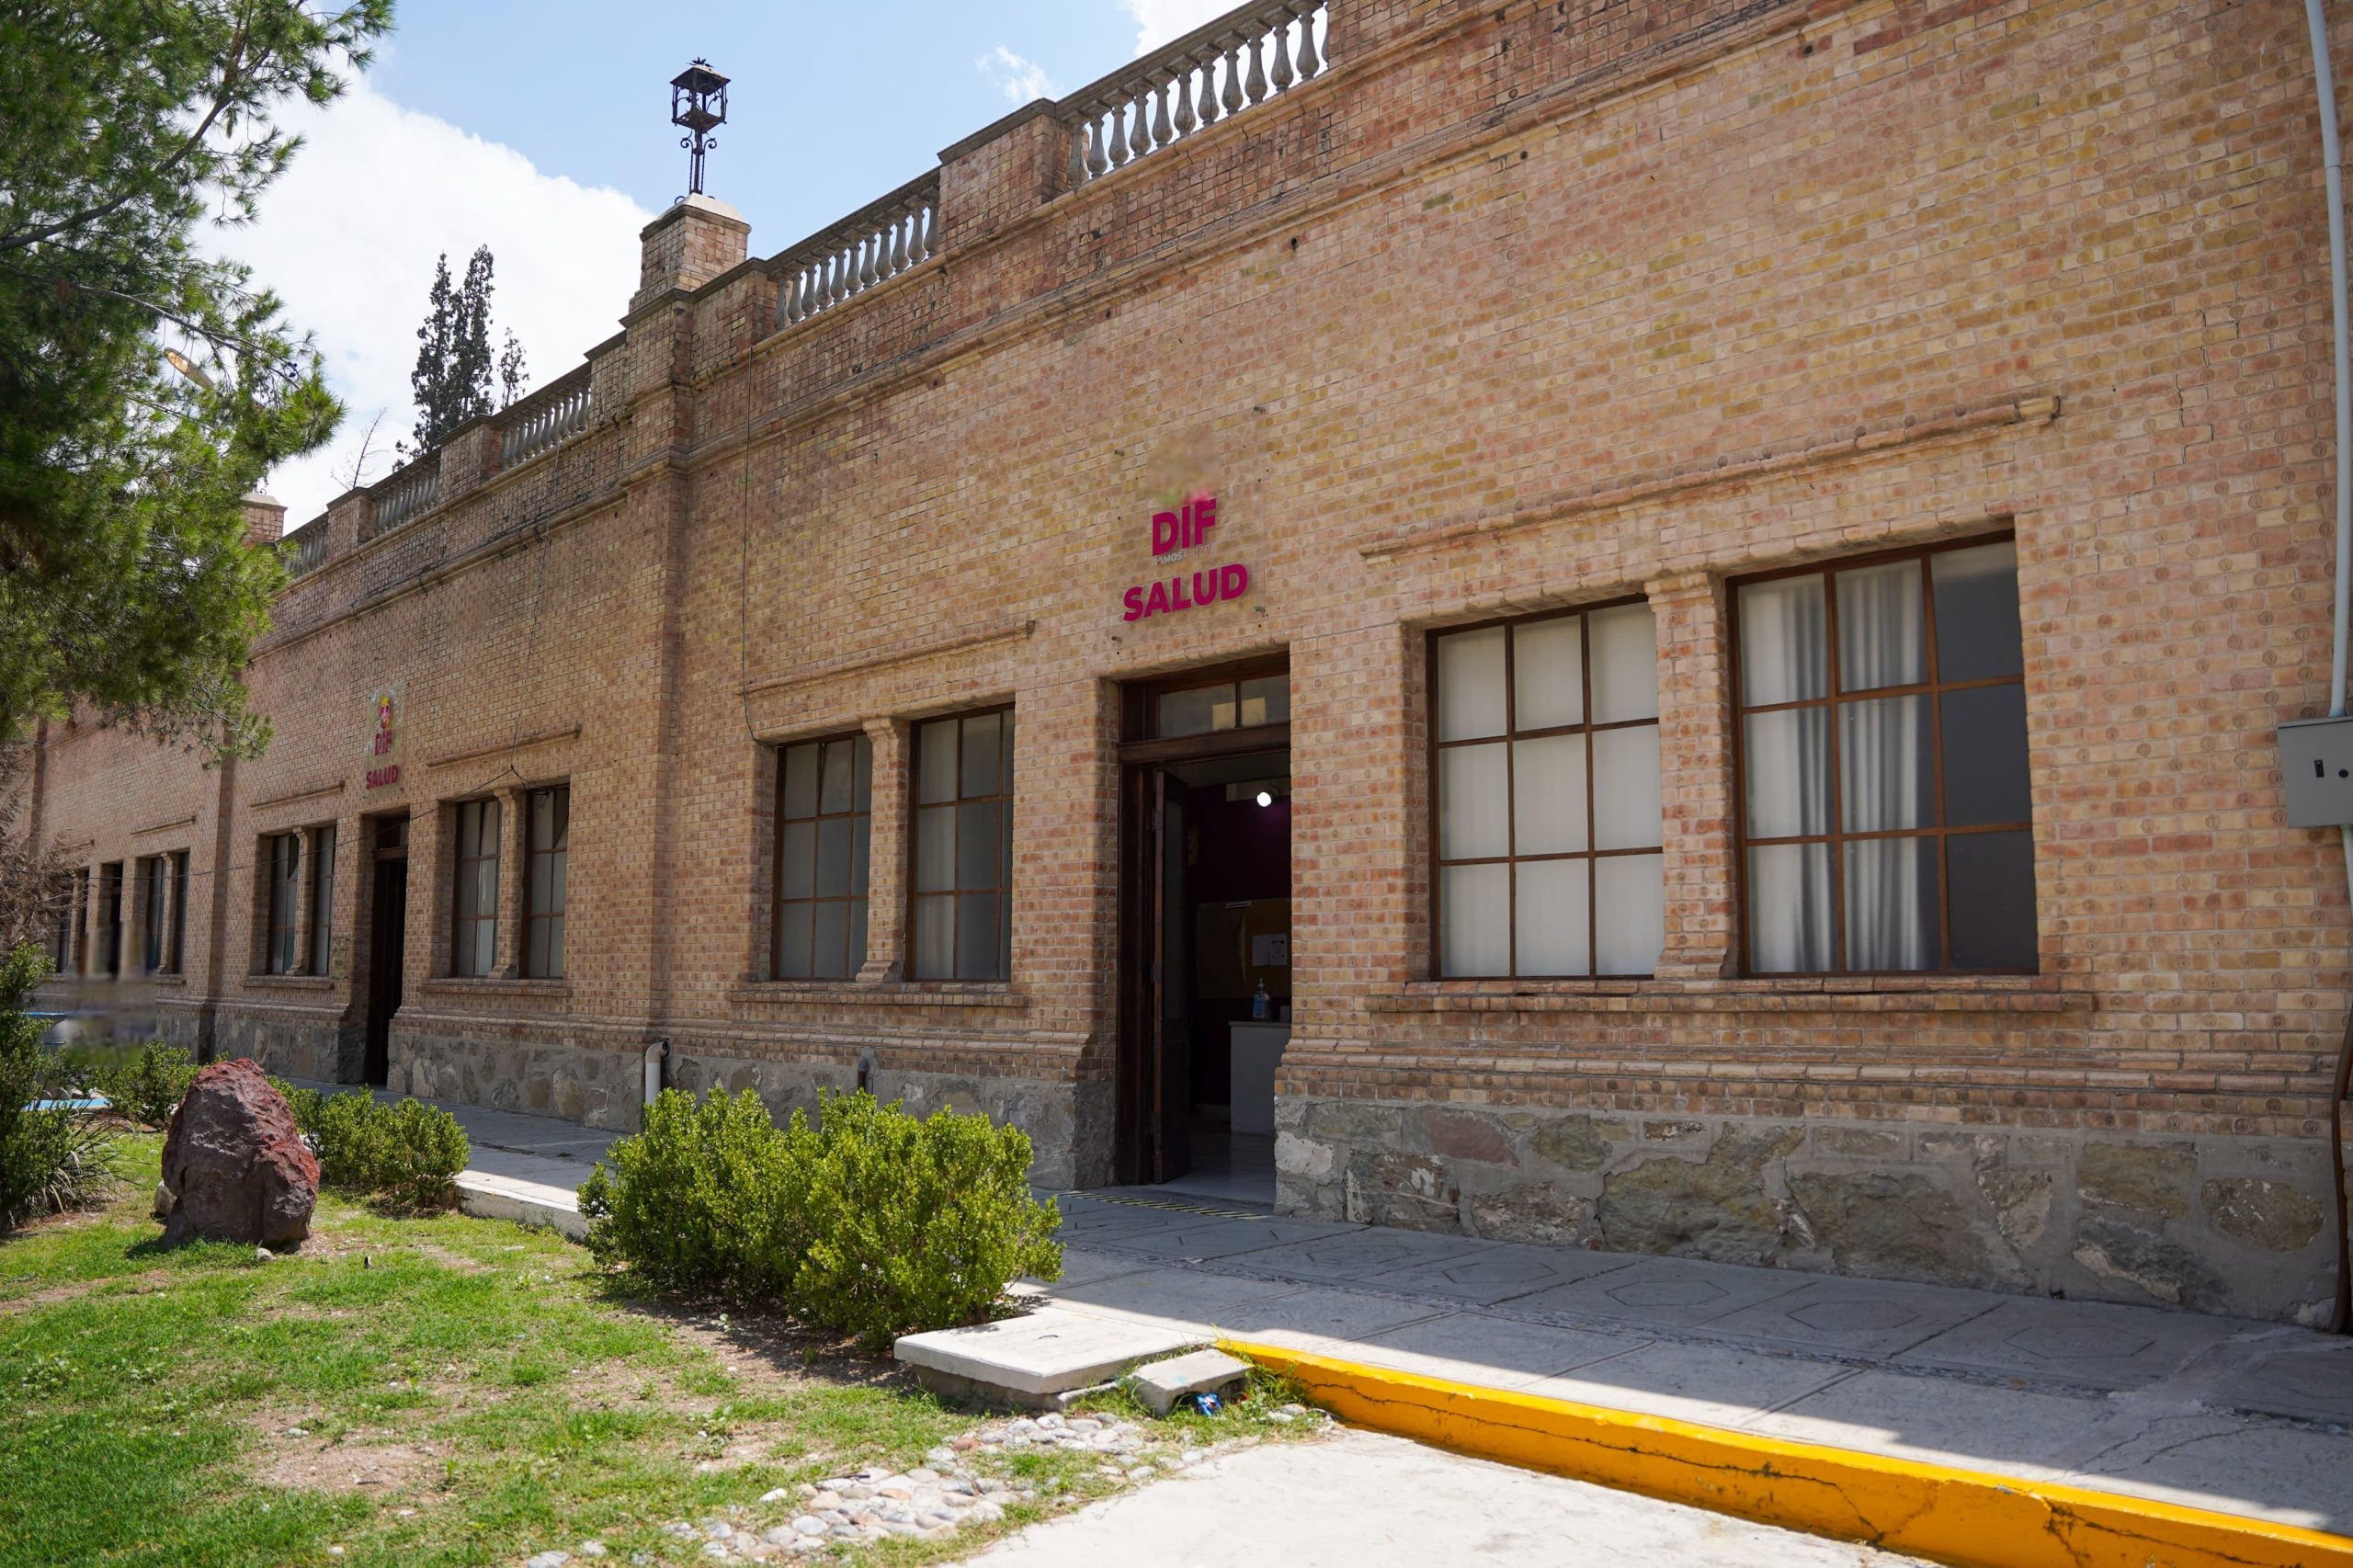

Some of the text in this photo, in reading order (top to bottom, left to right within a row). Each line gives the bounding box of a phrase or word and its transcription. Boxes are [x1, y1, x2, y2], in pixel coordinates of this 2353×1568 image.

[1152, 498, 1217, 556] DIF
[1123, 563, 1248, 622] SALUD
[374, 730, 392, 756] DIF
[366, 765, 398, 790] SALUD
